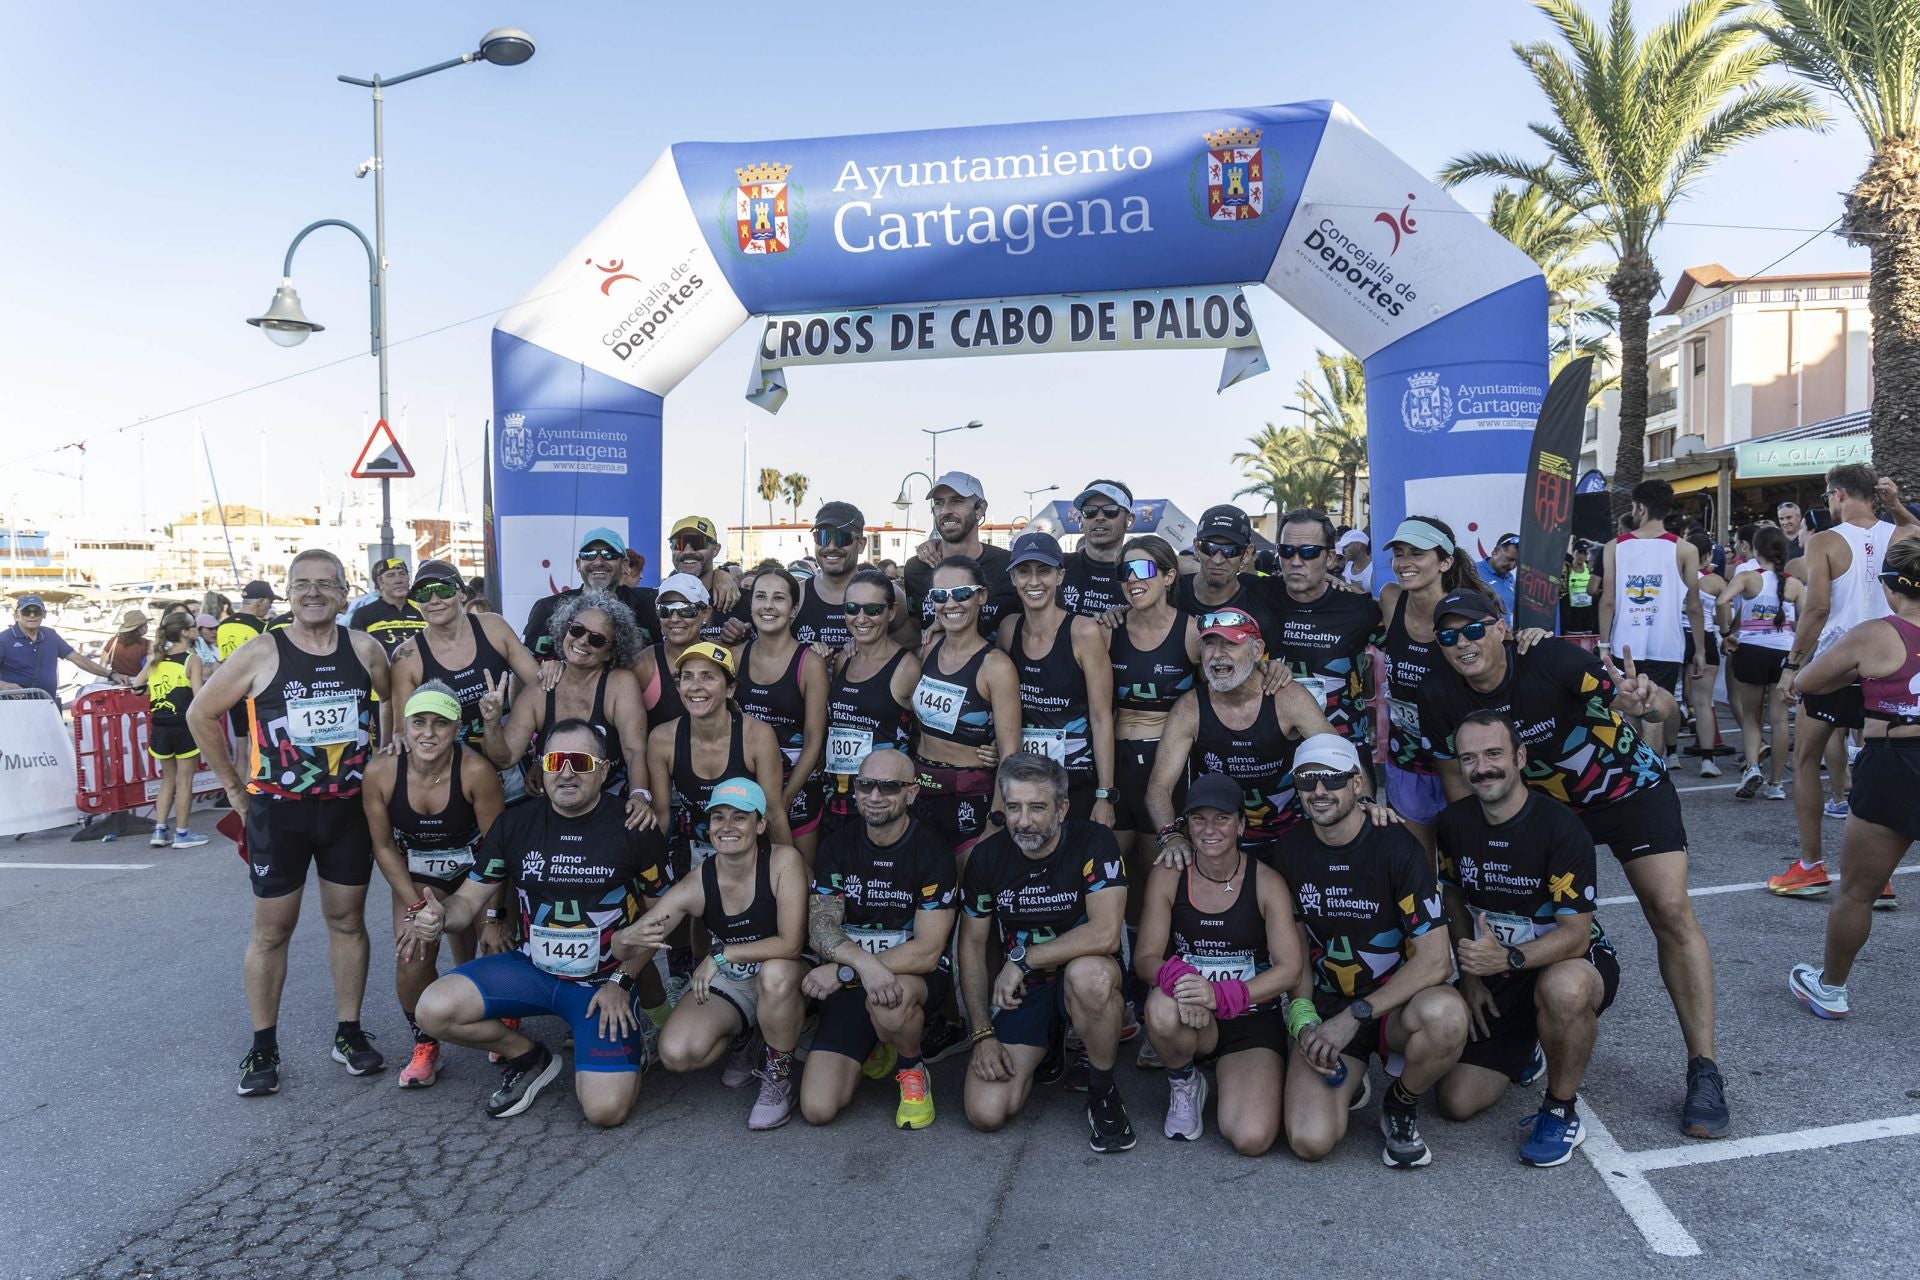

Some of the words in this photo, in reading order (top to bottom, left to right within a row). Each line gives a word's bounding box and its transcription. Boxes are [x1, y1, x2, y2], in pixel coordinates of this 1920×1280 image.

[831, 143, 1153, 199] Ayuntamiento
[833, 194, 1154, 255] Cartagena
[1318, 218, 1394, 285] Concejalía
[1395, 282, 1417, 302] de
[669, 262, 690, 282] de
[1303, 229, 1405, 317] Deportes
[611, 274, 704, 361] Deportes
[761, 315, 874, 360] CROSS
[890, 311, 935, 351] DE
[951, 302, 1054, 349] CABO
[1070, 300, 1117, 342] DE
[1133, 293, 1254, 340] PALOS
[1457, 383, 1542, 399] Ayuntamiento
[537, 427, 628, 442] Ayuntamiento
[537, 440, 628, 461] Cartagena
[1757, 450, 1778, 464] LA
[1788, 447, 1828, 461] OLA
[1084, 589, 1109, 600] alma
[1284, 620, 1311, 631] alma
[1283, 630, 1341, 644] fit&healthy
[1408, 644, 1429, 653] FASTER
[454, 668, 475, 680] FASTER
[1397, 661, 1426, 673] alma
[311, 680, 340, 689] alma
[744, 703, 768, 713] alma
[832, 701, 854, 711] alma
[919, 690, 952, 713] 1446
[302, 707, 348, 727] 1337
[833, 710, 880, 728] fit&healthy
[831, 739, 862, 756] 1307
[4, 751, 59, 771] Murcia
[1227, 755, 1255, 764] alma
[1228, 758, 1284, 772] fit&healthy
[560, 834, 583, 842] FASTER
[1488, 840, 1510, 848] FASTER
[551, 853, 582, 864] alma
[424, 859, 459, 873] 779
[550, 864, 616, 878] fit&healthy
[1484, 872, 1542, 889] fit&healthy
[889, 901, 907, 909] CLUB
[1018, 890, 1079, 906] fit&healthy
[1019, 905, 1052, 913] RUNNING
[1052, 904, 1072, 912] CLUB
[728, 919, 750, 928] FASTER
[725, 935, 757, 944] alma
[1193, 938, 1226, 948] alma
[542, 941, 589, 959] 1442
